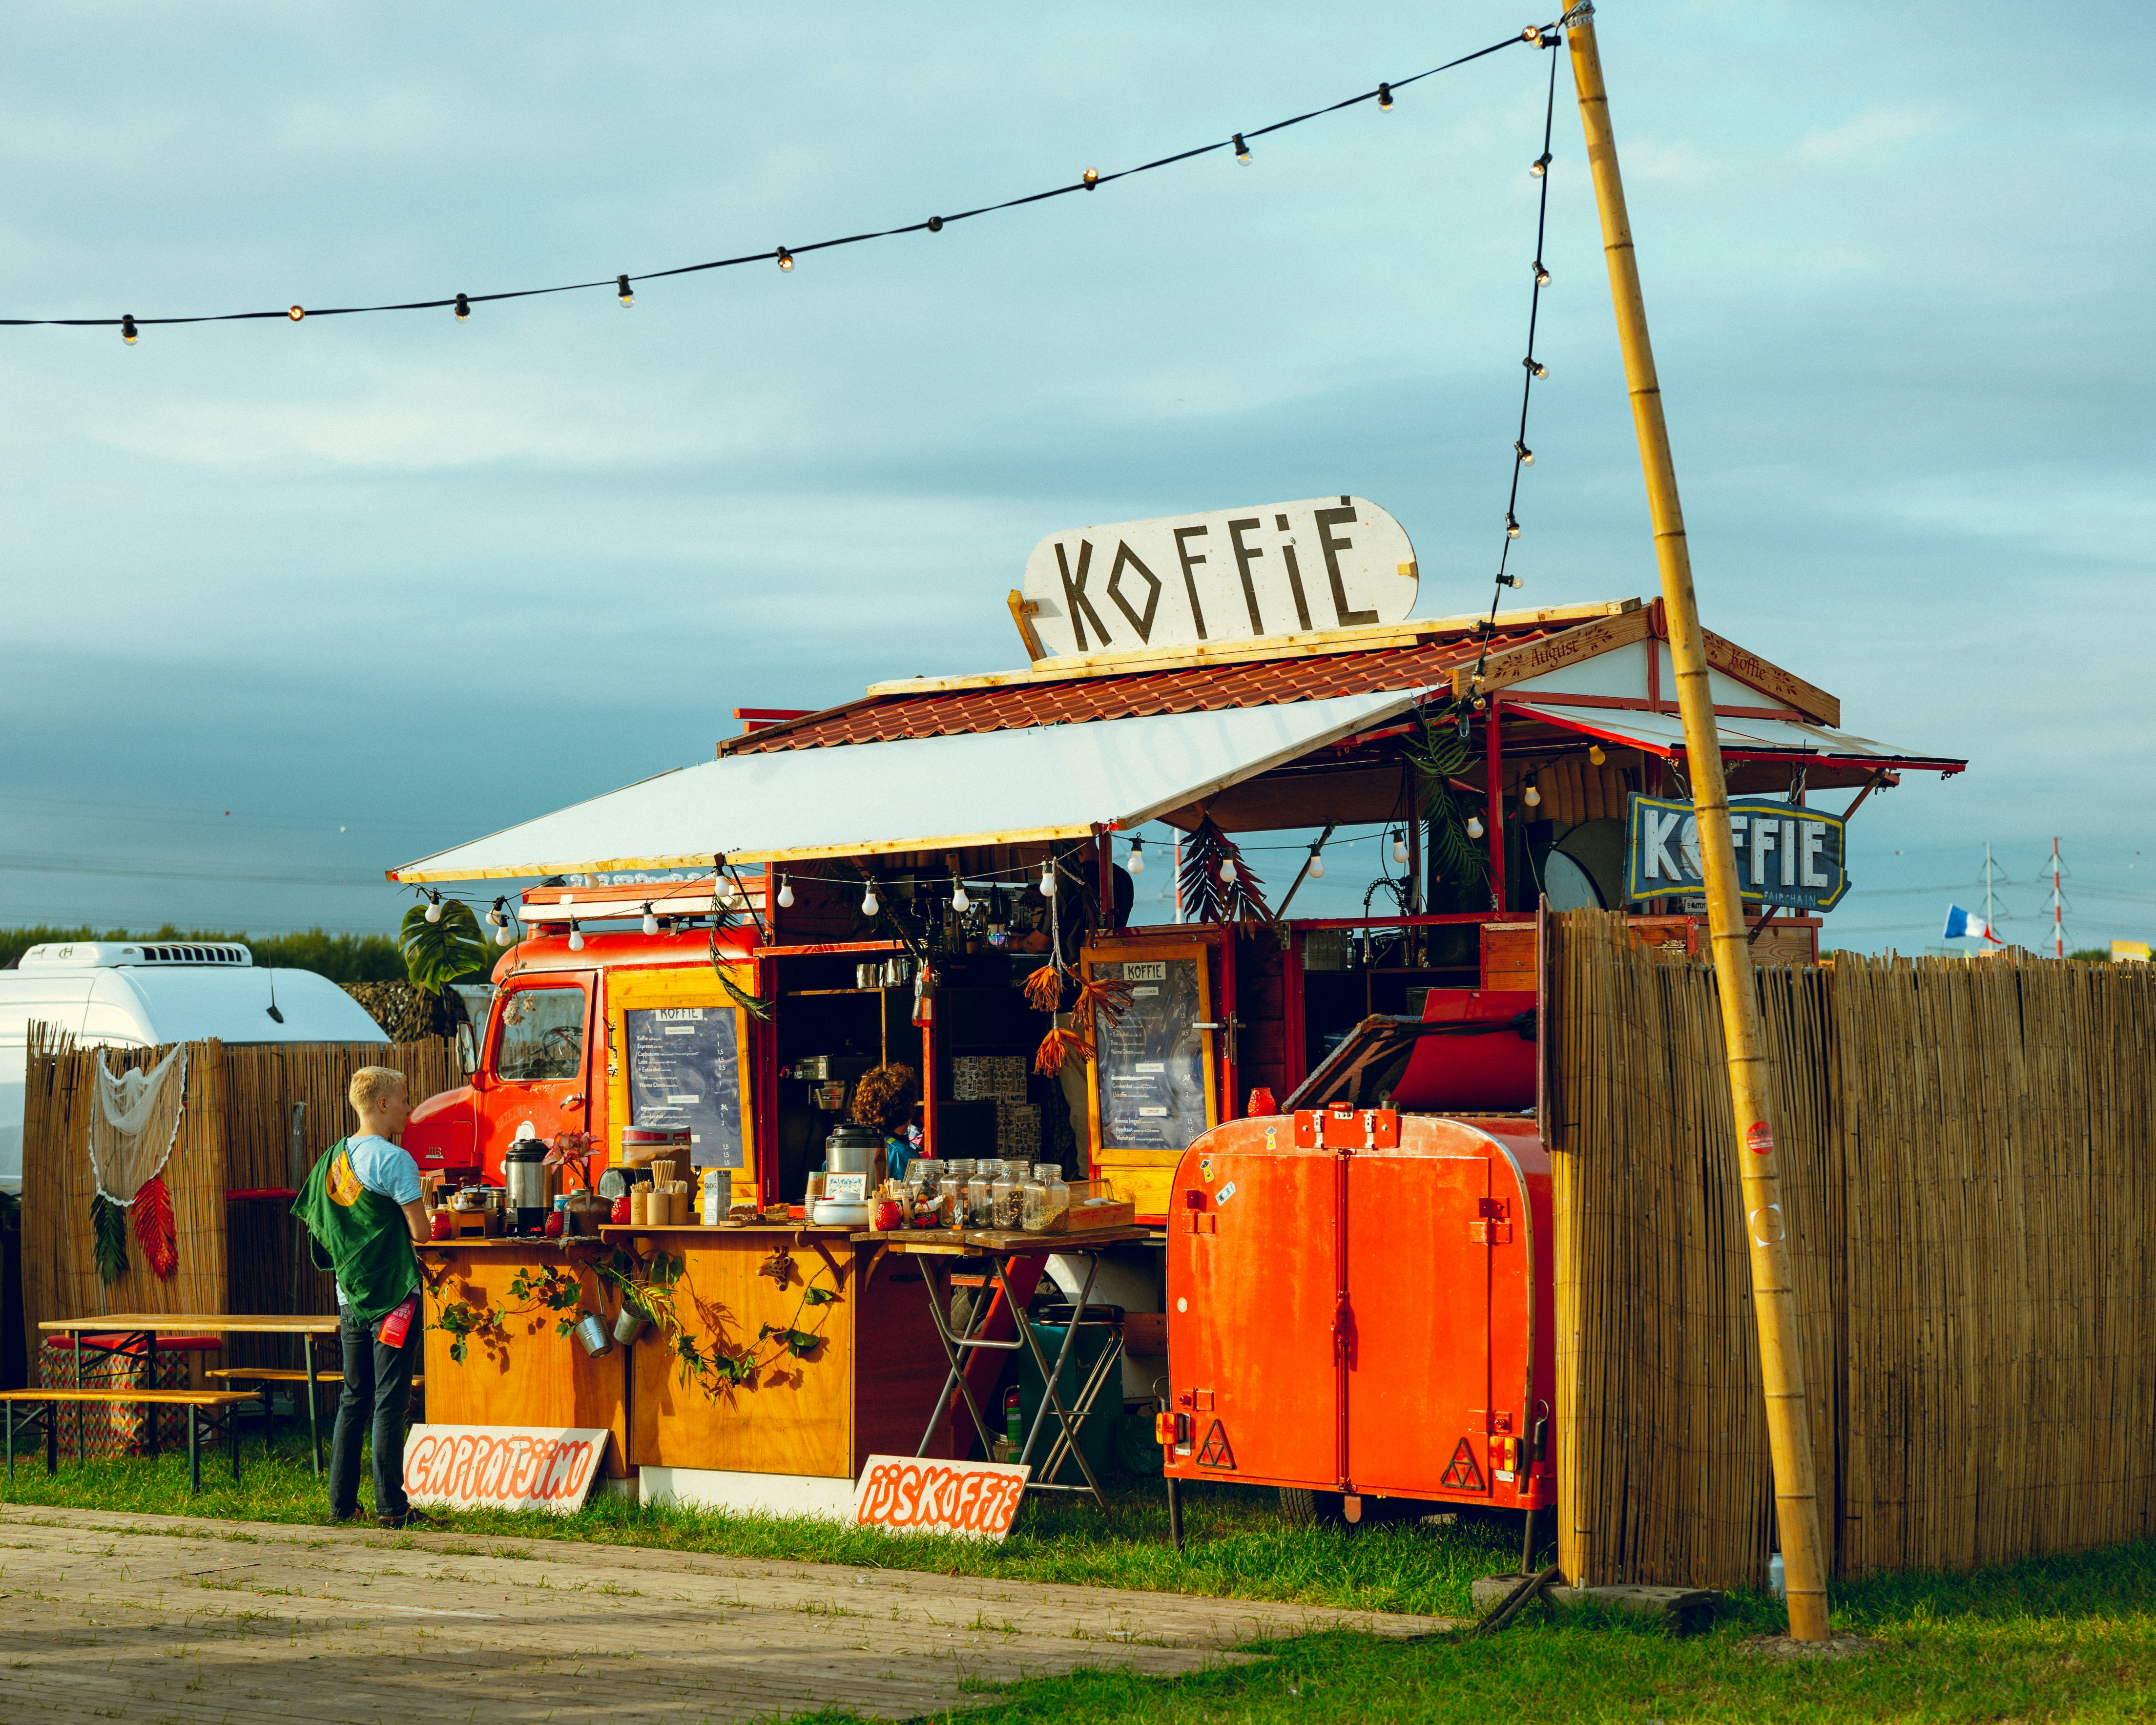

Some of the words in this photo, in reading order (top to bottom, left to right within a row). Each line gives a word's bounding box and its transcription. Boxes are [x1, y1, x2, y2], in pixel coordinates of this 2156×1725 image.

[1531, 639, 1579, 668] August
[1730, 648, 1768, 681] Koffie
[1763, 891, 1816, 908] FAIRCHAIN
[1127, 964, 1162, 979] KOFFIE
[1128, 1117, 1141, 1125] (vegan)
[429, 1146, 442, 1157] 1113
